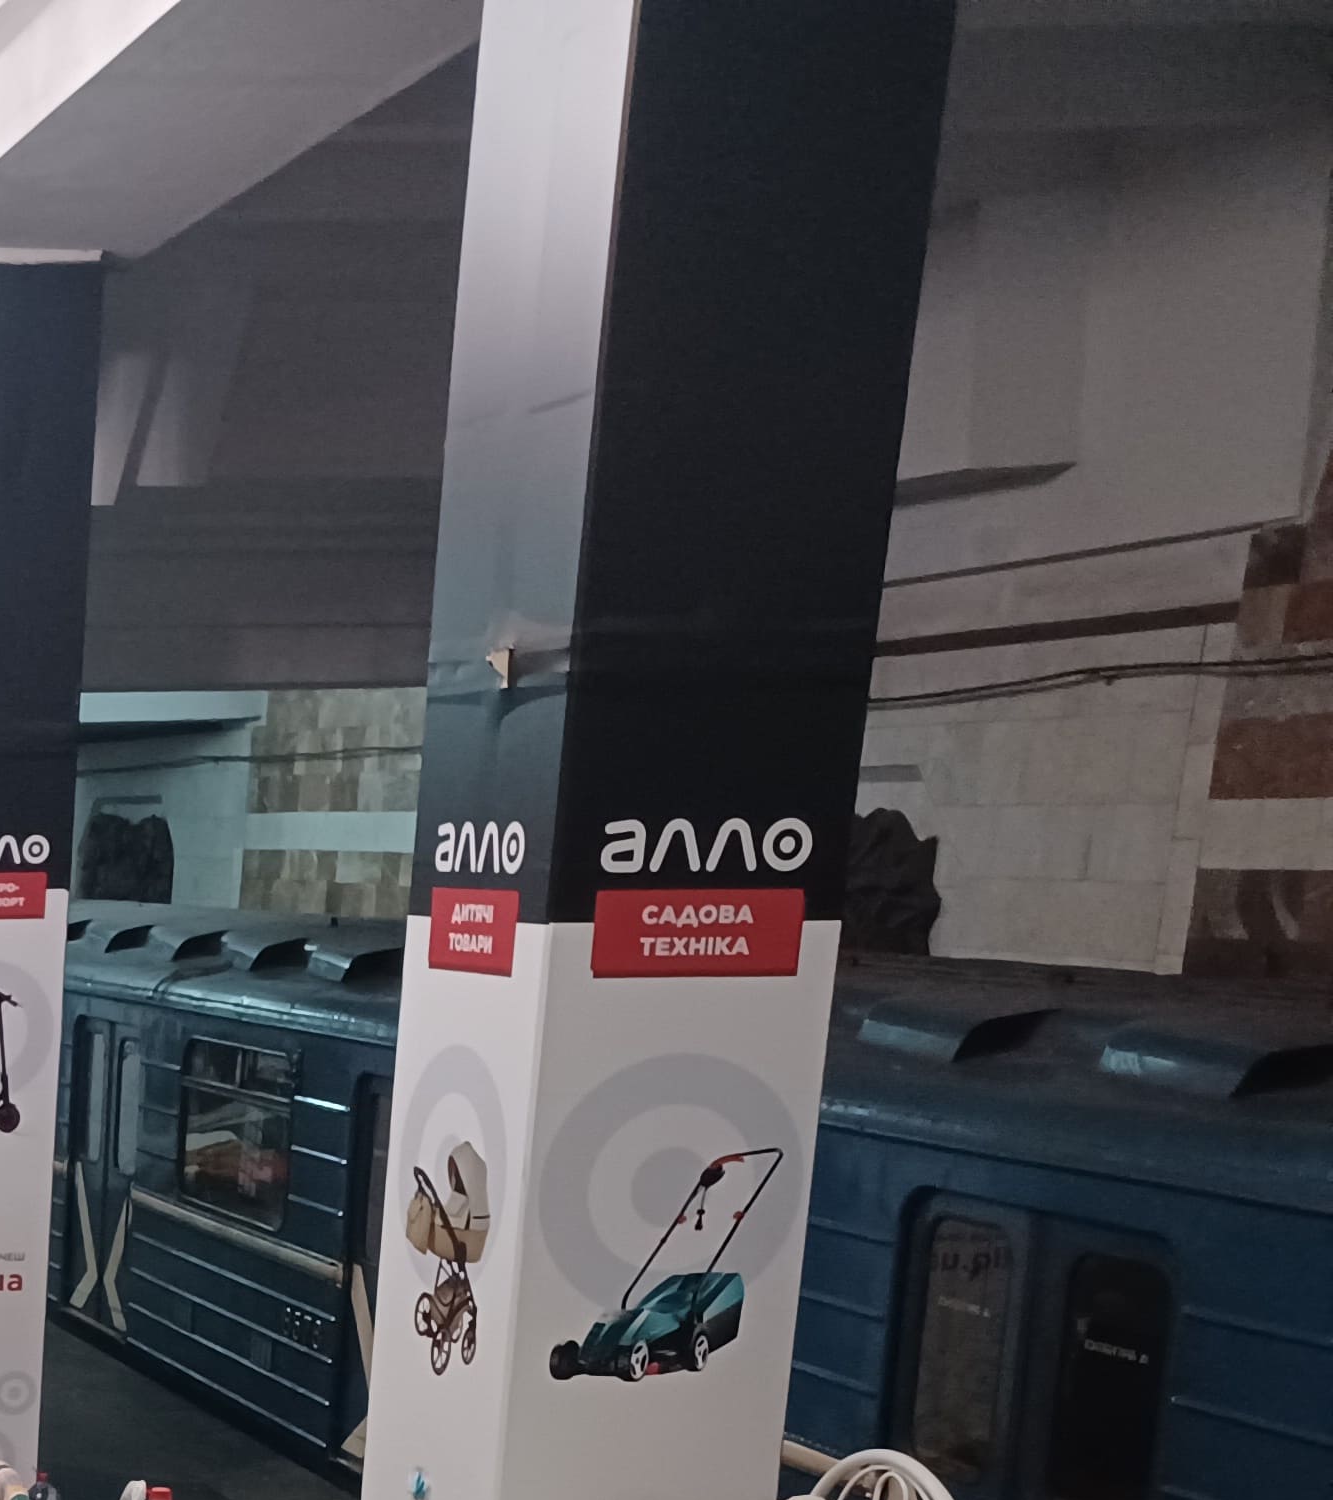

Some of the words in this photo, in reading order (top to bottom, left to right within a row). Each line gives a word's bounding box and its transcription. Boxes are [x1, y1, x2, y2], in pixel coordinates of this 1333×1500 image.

[434, 820, 526, 875] алло
[600, 817, 813, 874] алло
[450, 903, 494, 924] ДИТЯЧІ
[641, 904, 754, 928] САДОВА
[448, 932, 493, 955] ТОВАРИ
[640, 935, 750, 957] ТЕХНІКА
